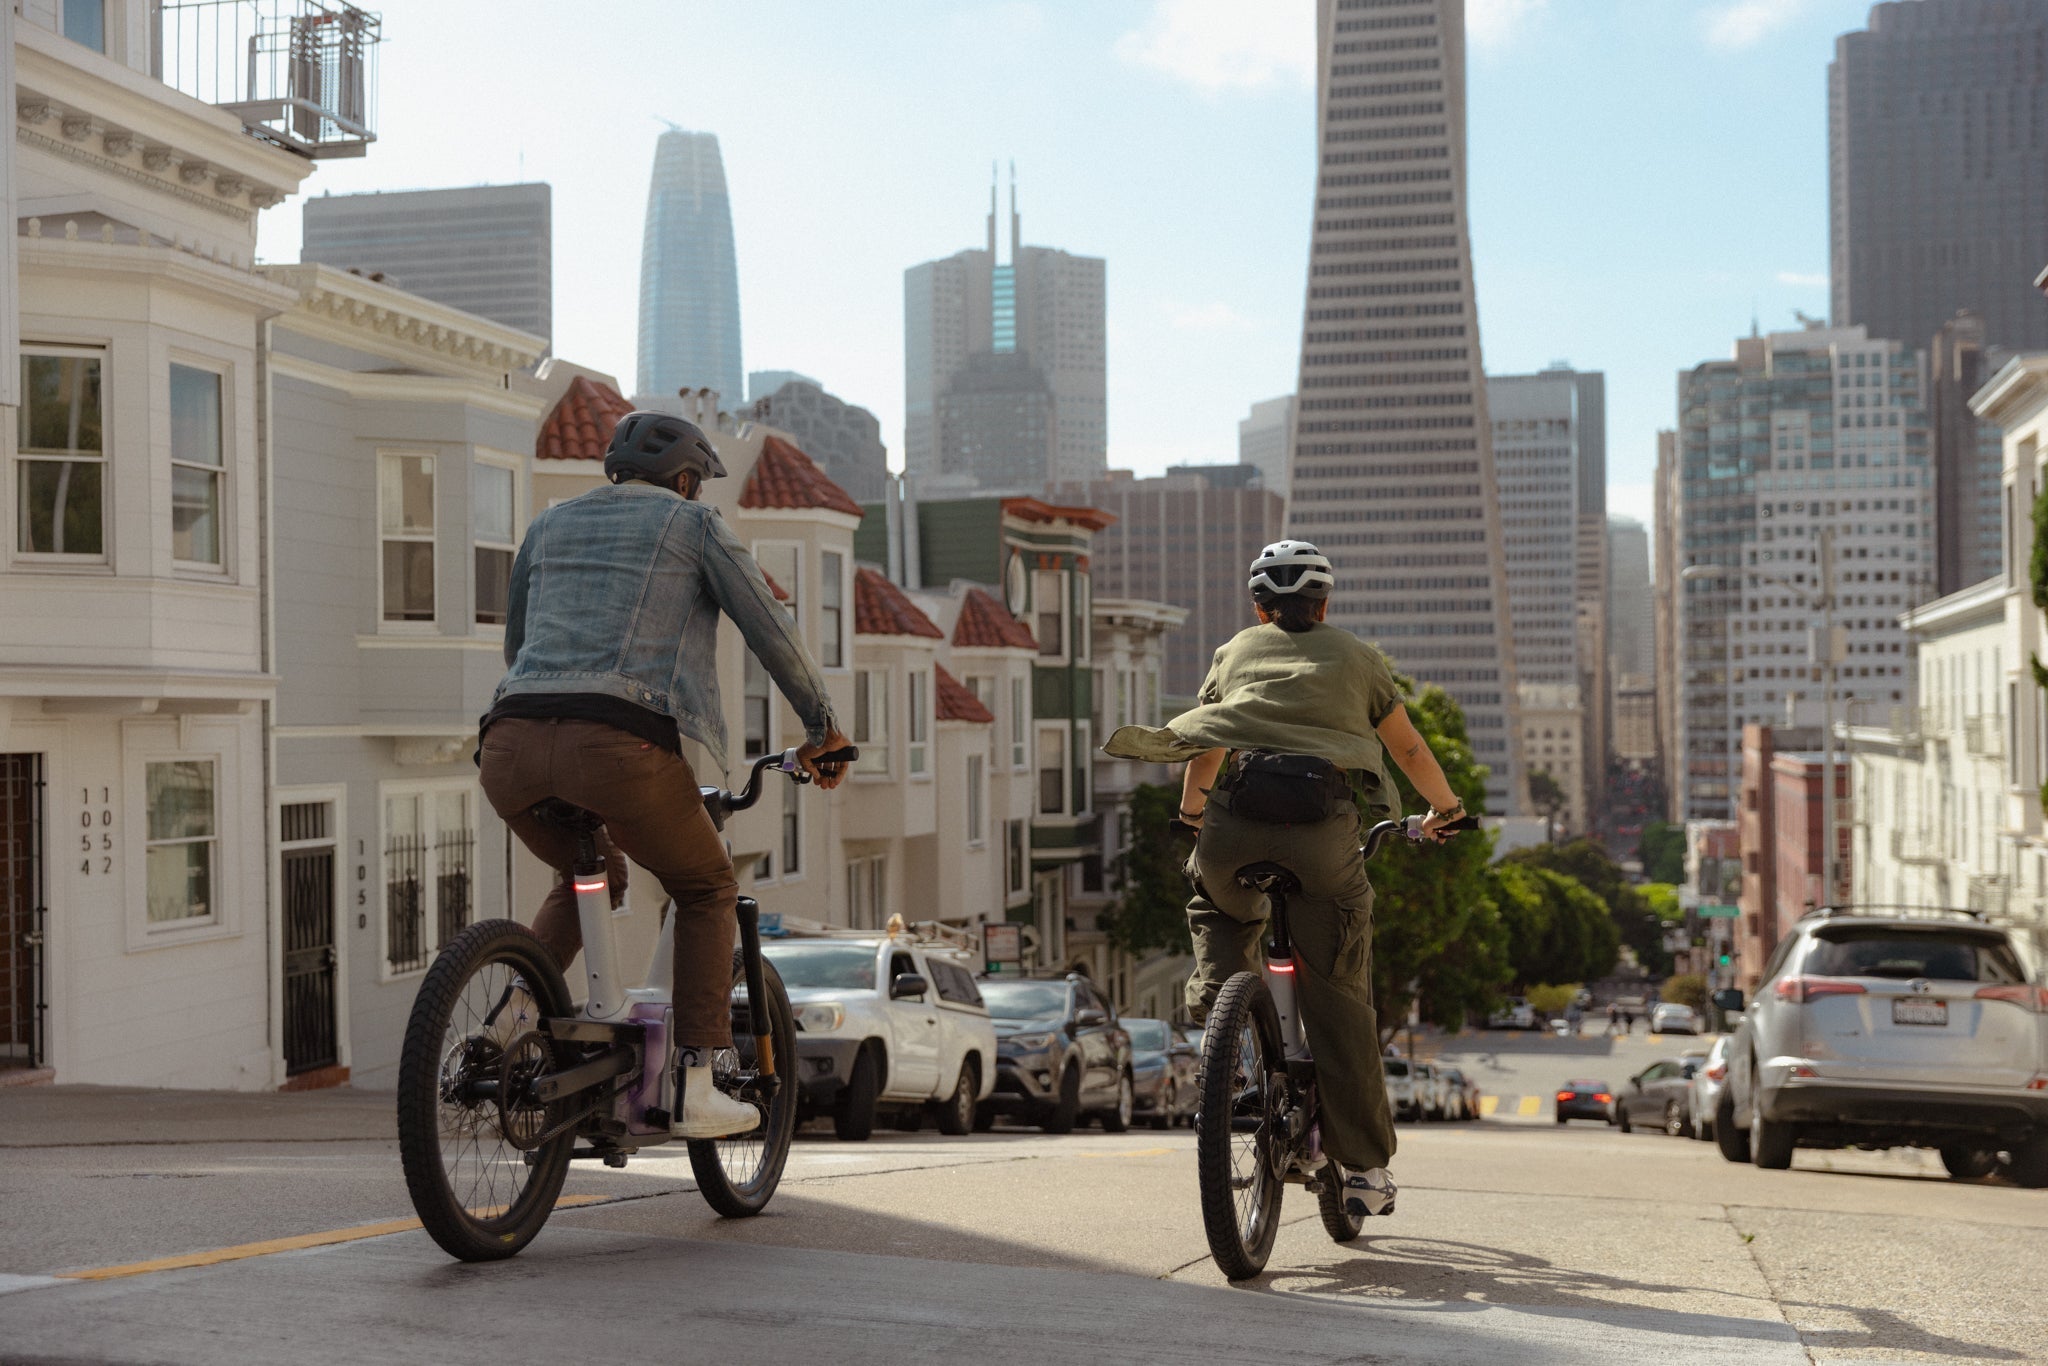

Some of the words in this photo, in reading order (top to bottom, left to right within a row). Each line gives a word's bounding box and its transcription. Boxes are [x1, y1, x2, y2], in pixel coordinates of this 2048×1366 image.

[81, 788, 91, 875] 1054
[102, 787, 112, 874] 1052
[358, 839, 367, 929] 1050
